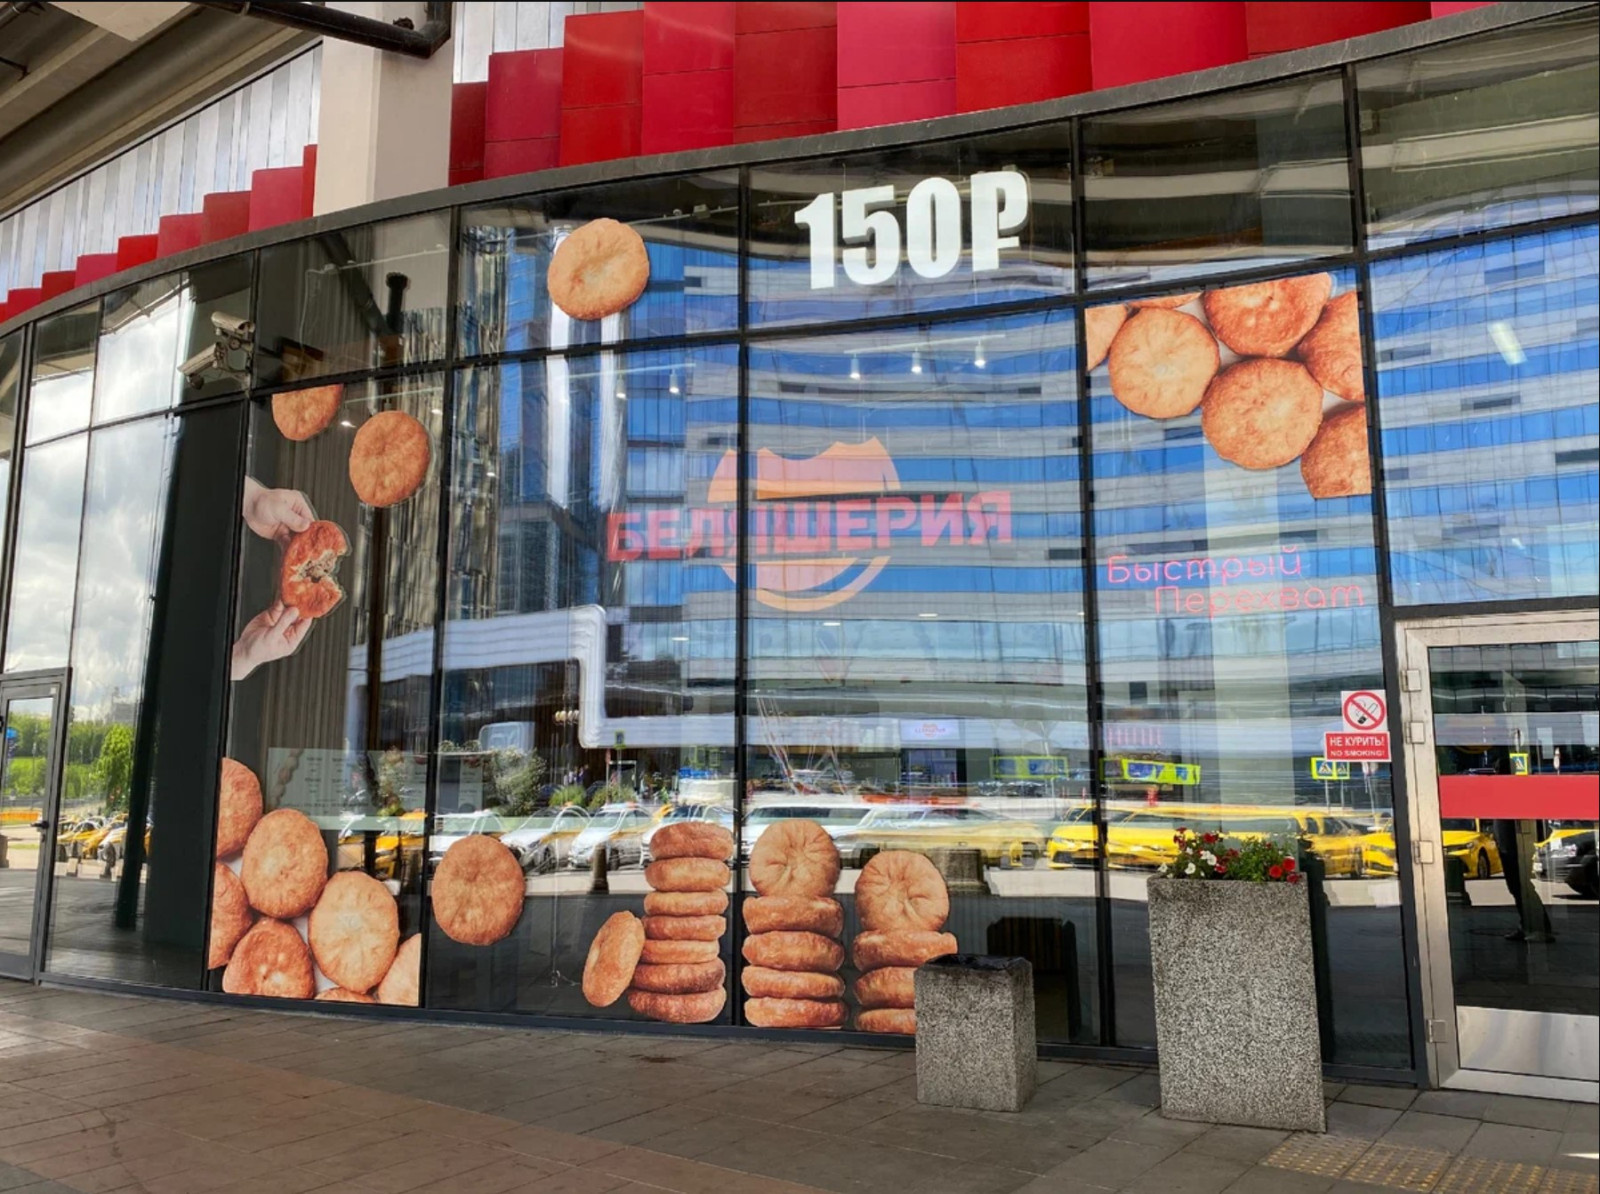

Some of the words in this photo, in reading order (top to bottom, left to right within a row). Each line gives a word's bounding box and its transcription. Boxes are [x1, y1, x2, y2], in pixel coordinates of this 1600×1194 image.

[1106, 544, 1301, 586] Быстрый
[1154, 584, 1365, 619] Перехват
[1329, 737, 1343, 747] НЕ
[1345, 736, 1385, 747] КУРИТЬ!
